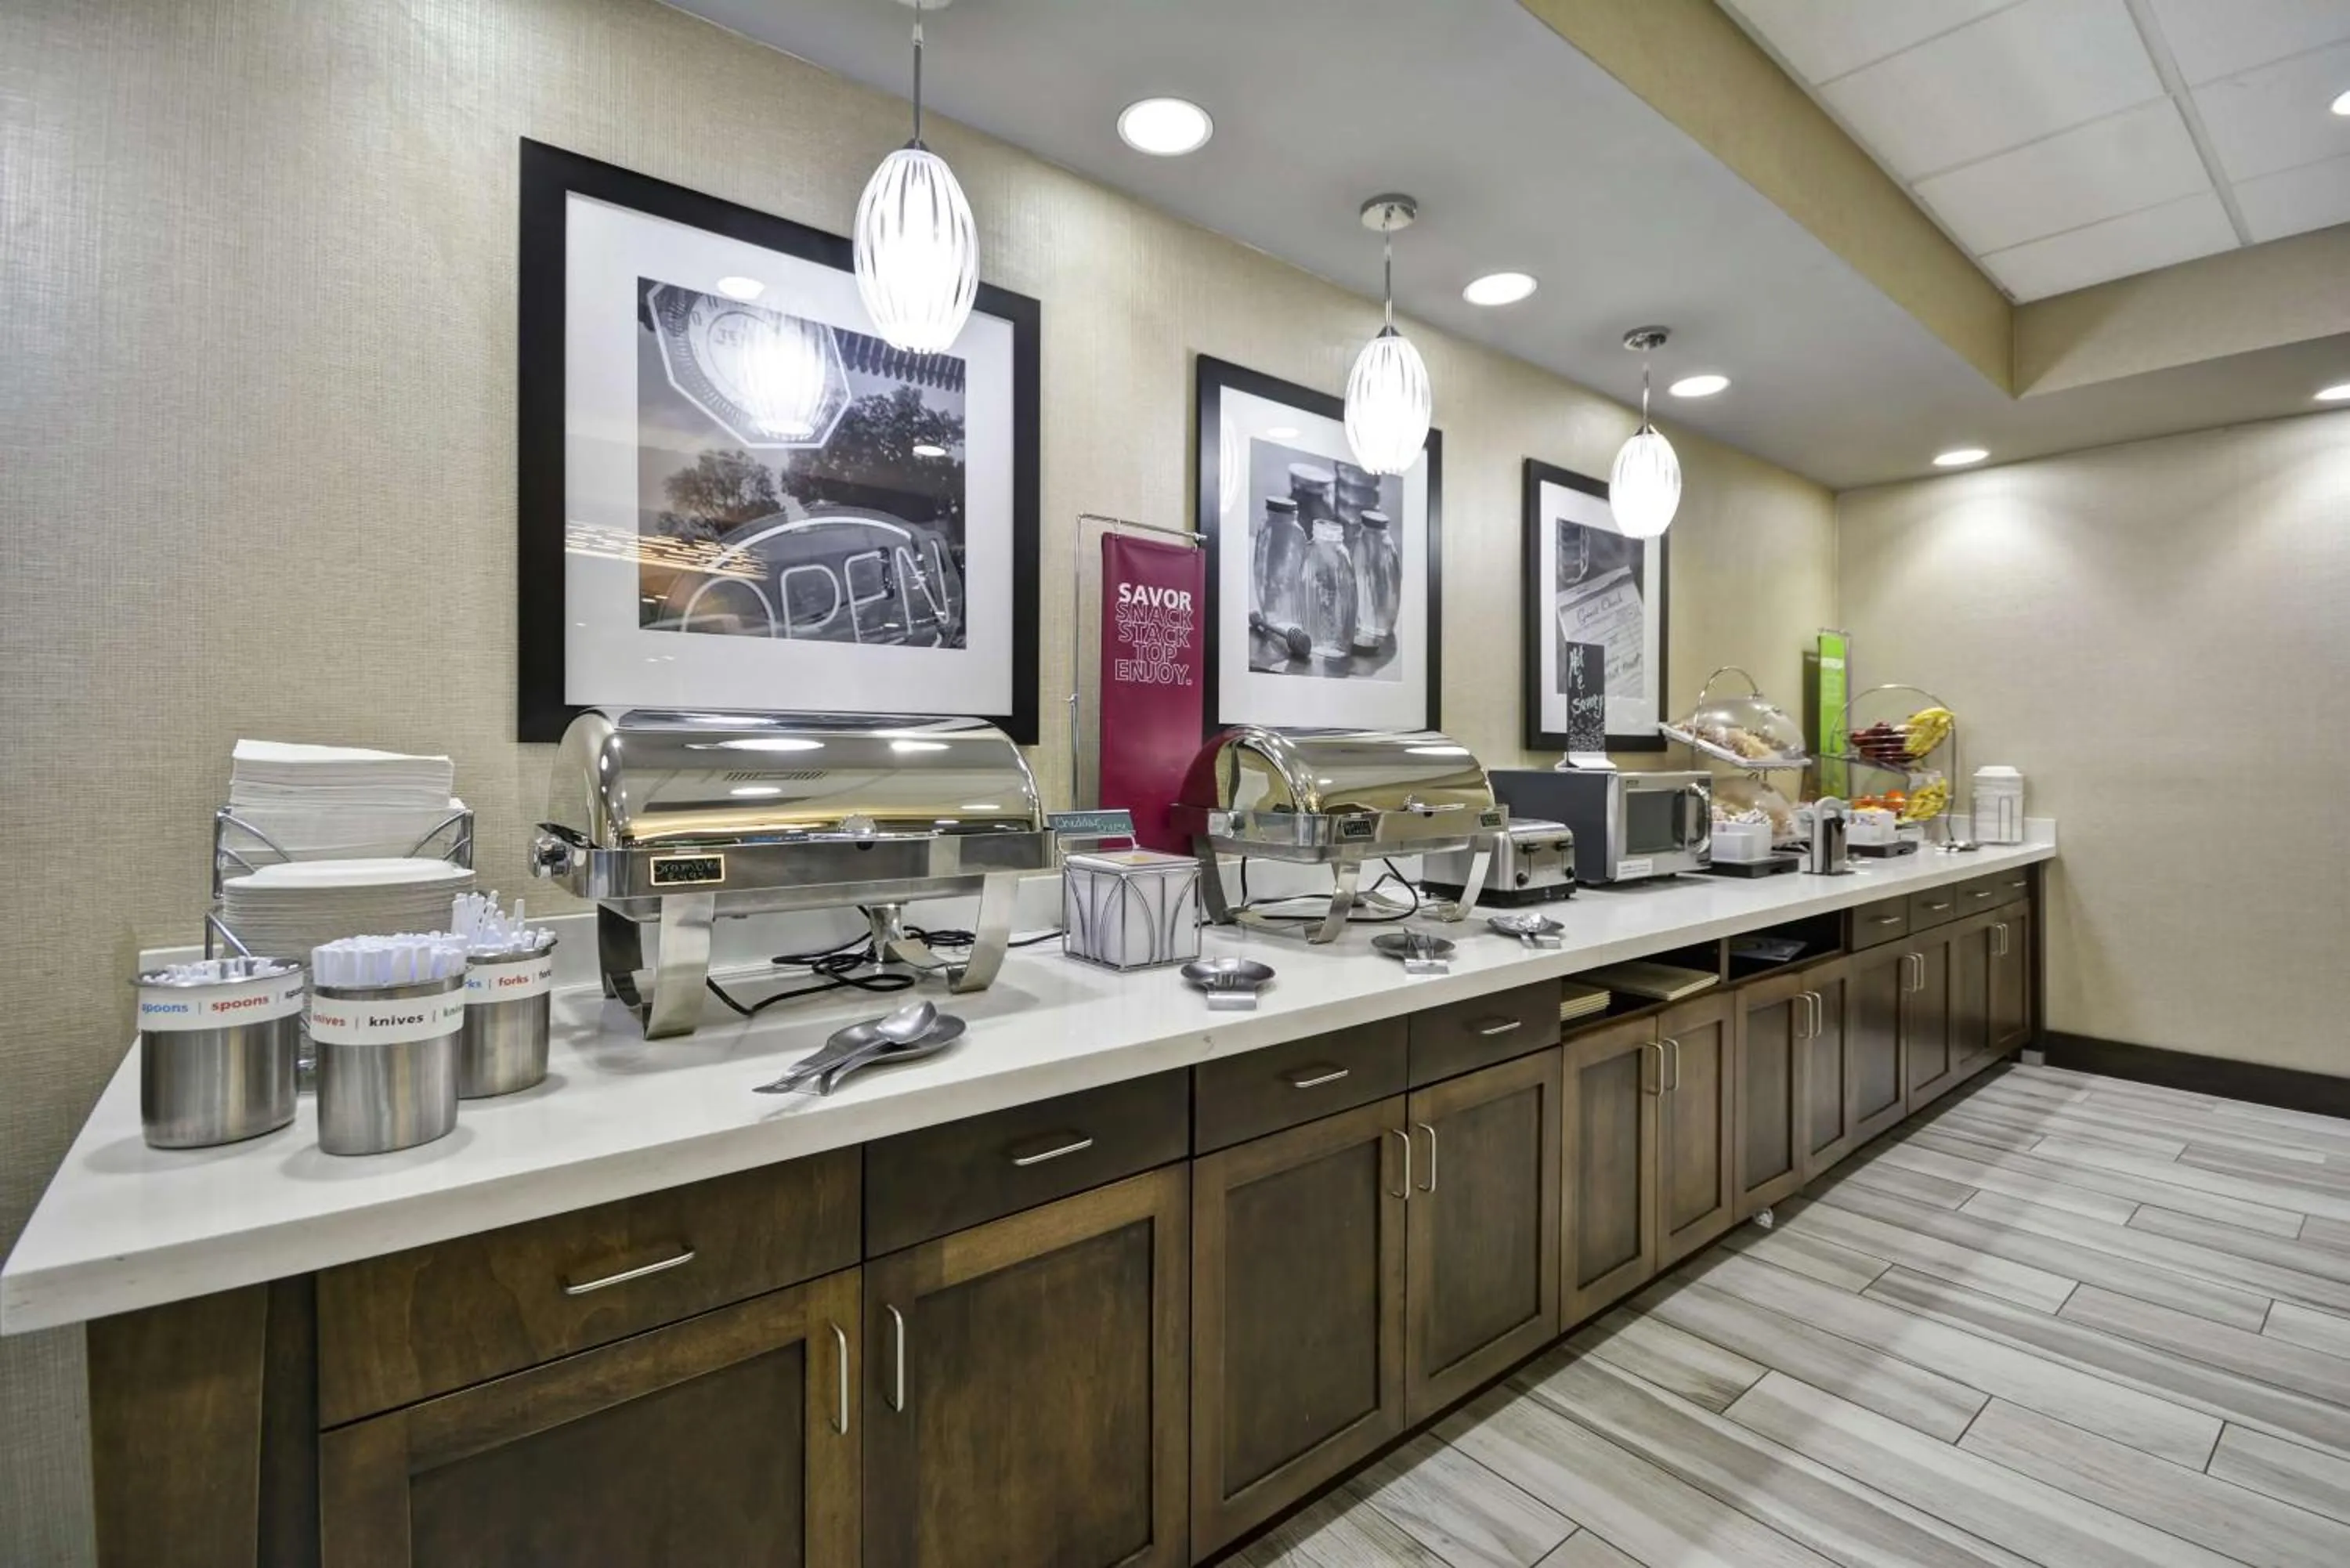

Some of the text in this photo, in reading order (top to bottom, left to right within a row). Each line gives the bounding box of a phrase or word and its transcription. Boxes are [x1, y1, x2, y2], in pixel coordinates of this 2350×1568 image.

[1118, 583, 1191, 611] SAVOR
[1115, 602, 1194, 630] SNACK
[1118, 620, 1190, 648] STACK
[1132, 641, 1177, 664] TOP
[1115, 659, 1192, 685] ENJOY.
[498, 974, 530, 987] forks
[211, 995, 270, 1013] spoons
[369, 1014, 425, 1028] knives
